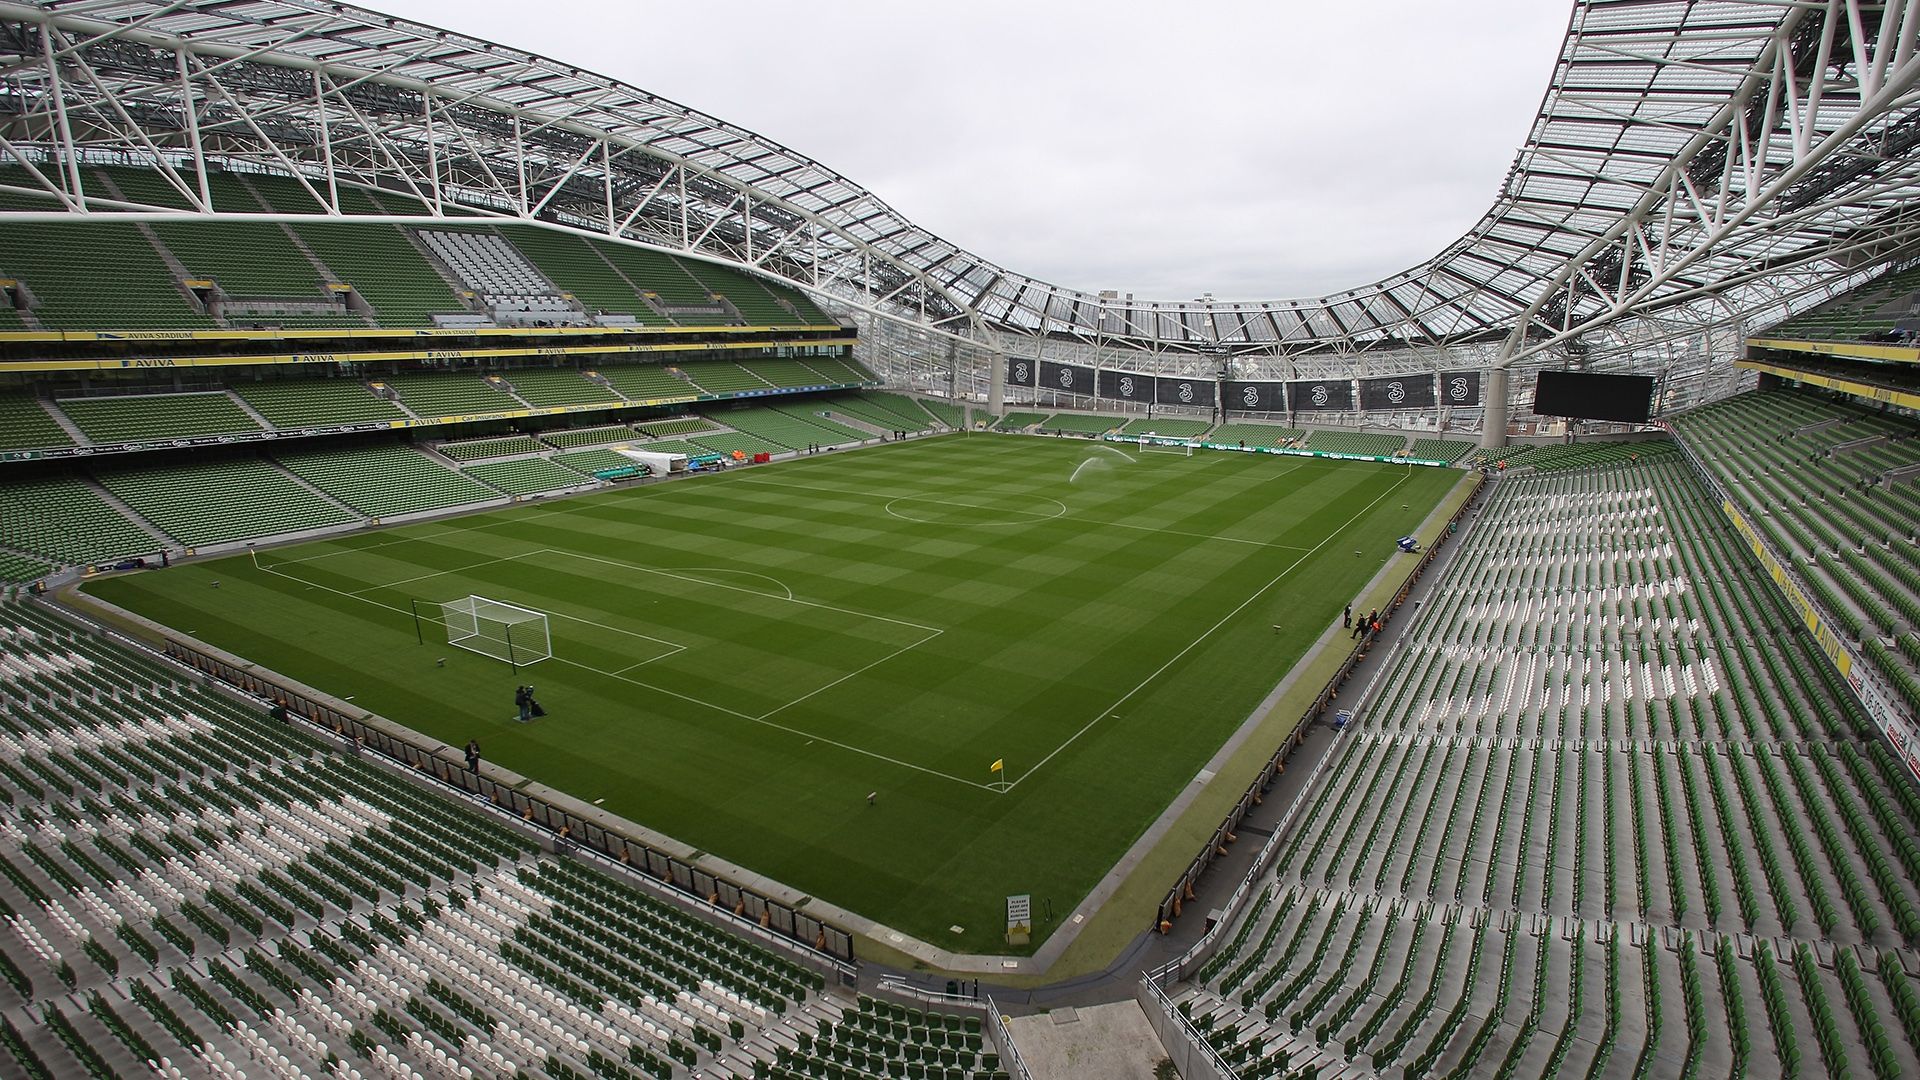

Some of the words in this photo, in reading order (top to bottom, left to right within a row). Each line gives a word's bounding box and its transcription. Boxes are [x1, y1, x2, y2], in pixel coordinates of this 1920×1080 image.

[135, 359, 176, 368] AVIVA
[1015, 362, 1028, 380] 3
[1060, 368, 1073, 385] 3
[1120, 377, 1133, 395] 3
[1179, 383, 1193, 400] 3
[1312, 385, 1328, 404] 3
[1387, 381, 1405, 401] 3
[1451, 377, 1468, 398] 3
[1243, 386, 1258, 405] 3
[415, 417, 442, 426] AVIVA
[1819, 628, 1840, 666] AVIVA
[1888, 723, 1908, 751] newstalk
